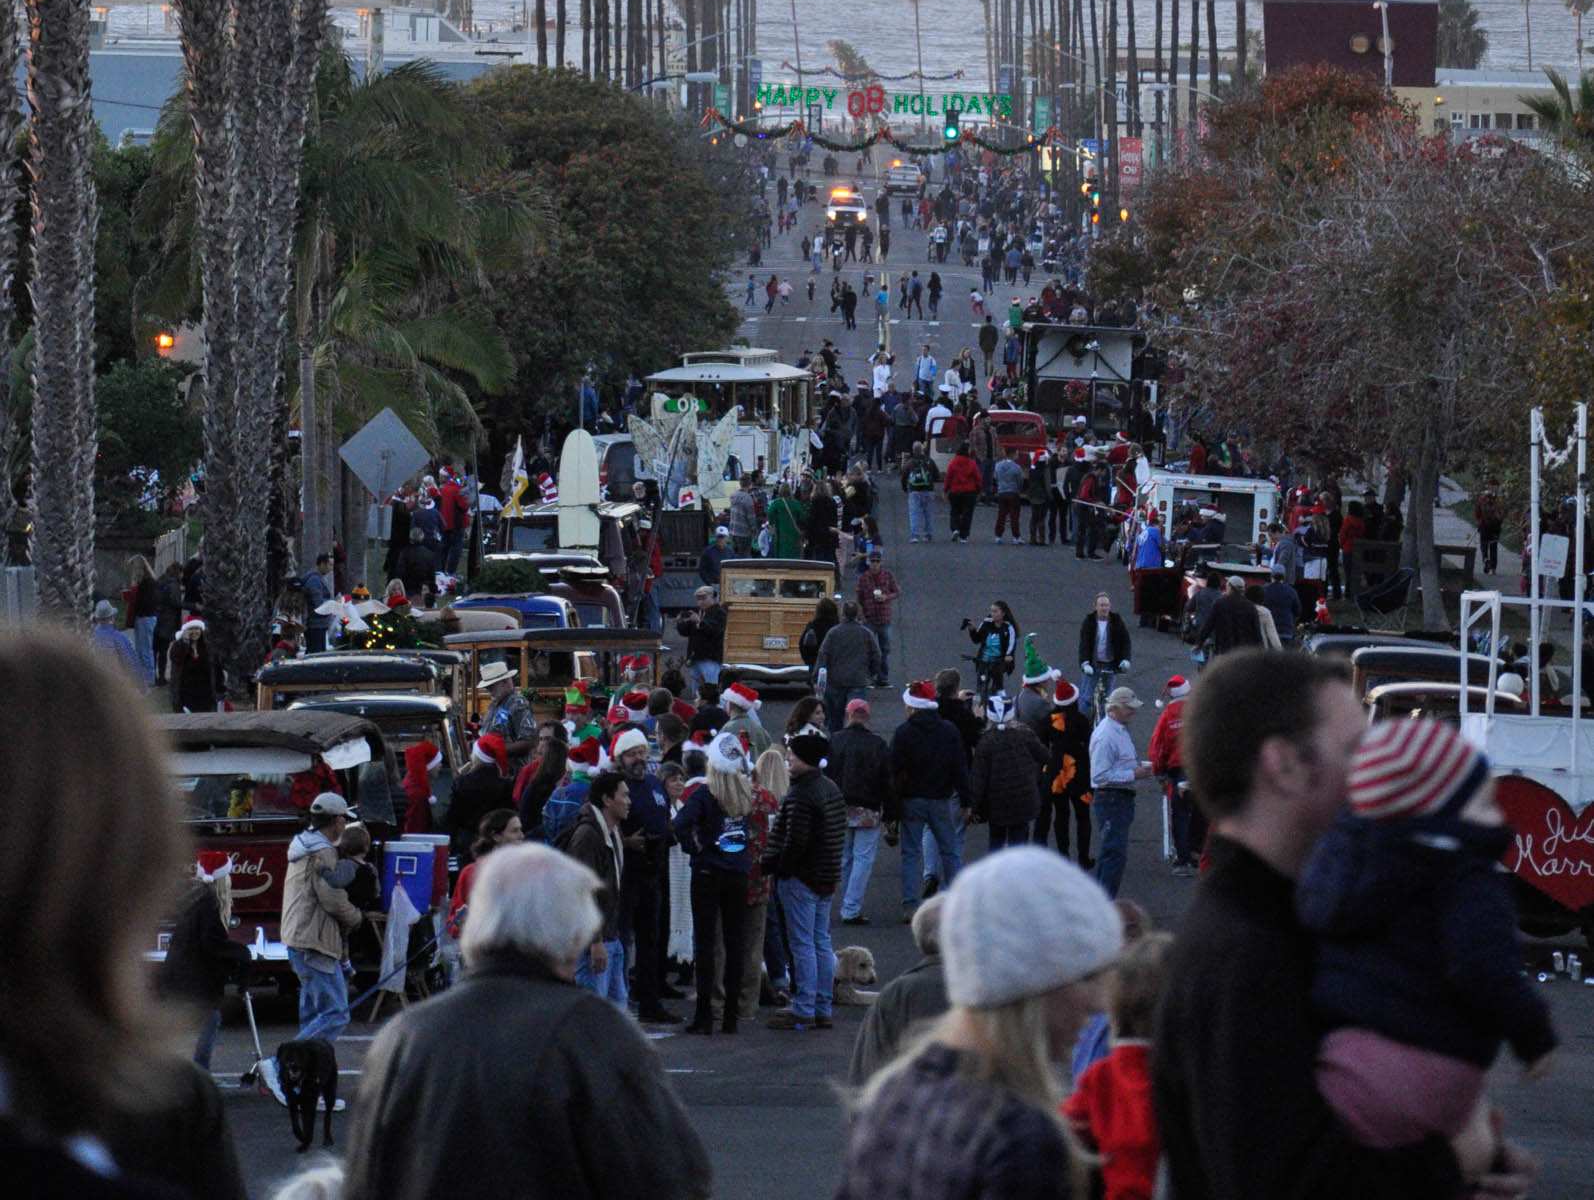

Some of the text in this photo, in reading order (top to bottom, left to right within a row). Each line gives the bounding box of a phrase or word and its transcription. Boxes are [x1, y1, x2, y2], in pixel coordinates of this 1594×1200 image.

[757, 83, 838, 110] HAPPY
[847, 84, 885, 118] OB
[894, 95, 1013, 116] HOLIDAYS
